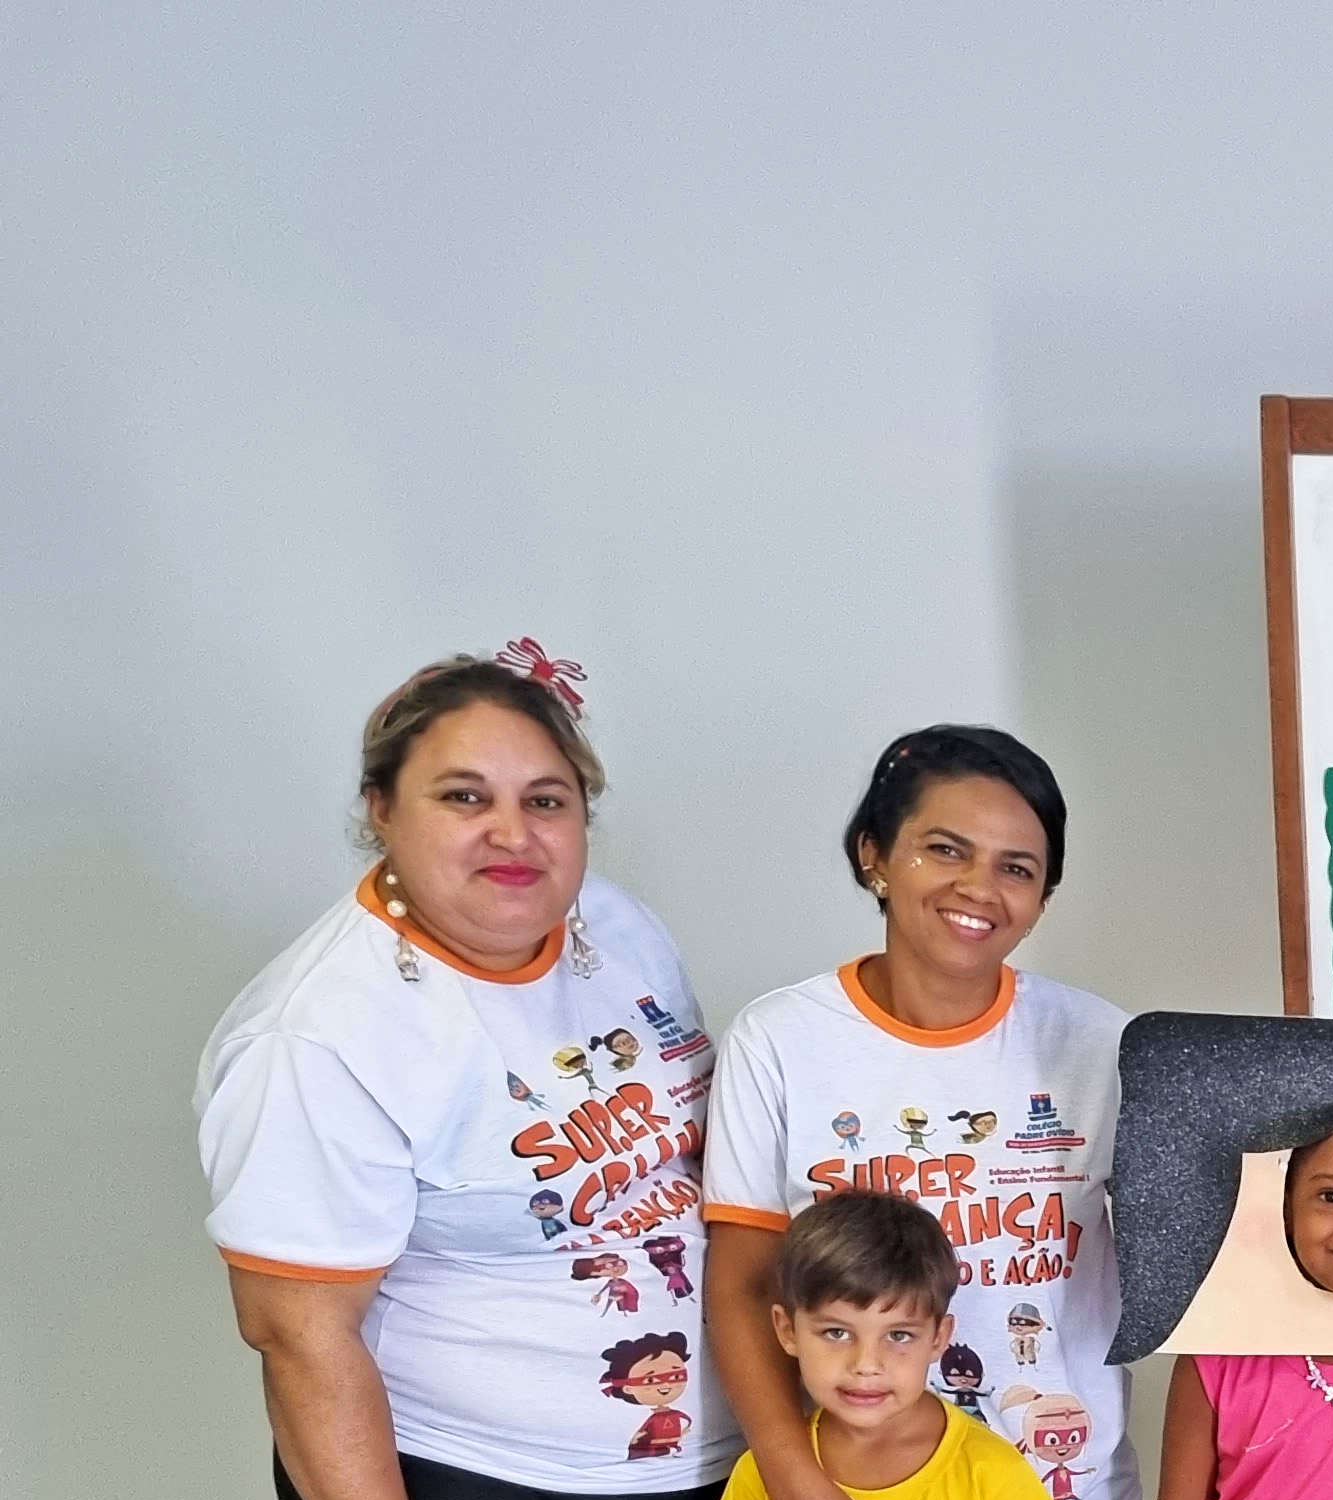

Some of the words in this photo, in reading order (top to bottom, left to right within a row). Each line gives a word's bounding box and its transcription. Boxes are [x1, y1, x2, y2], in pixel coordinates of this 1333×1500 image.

[510, 1082, 671, 1182] SUPER
[807, 1153, 977, 1204] SUPER
[988, 1167, 1031, 1177] Educação
[997, 1177, 1028, 1185] Ensino
[937, 1192, 1065, 1252] ANÇA
[980, 1258, 997, 1286] E
